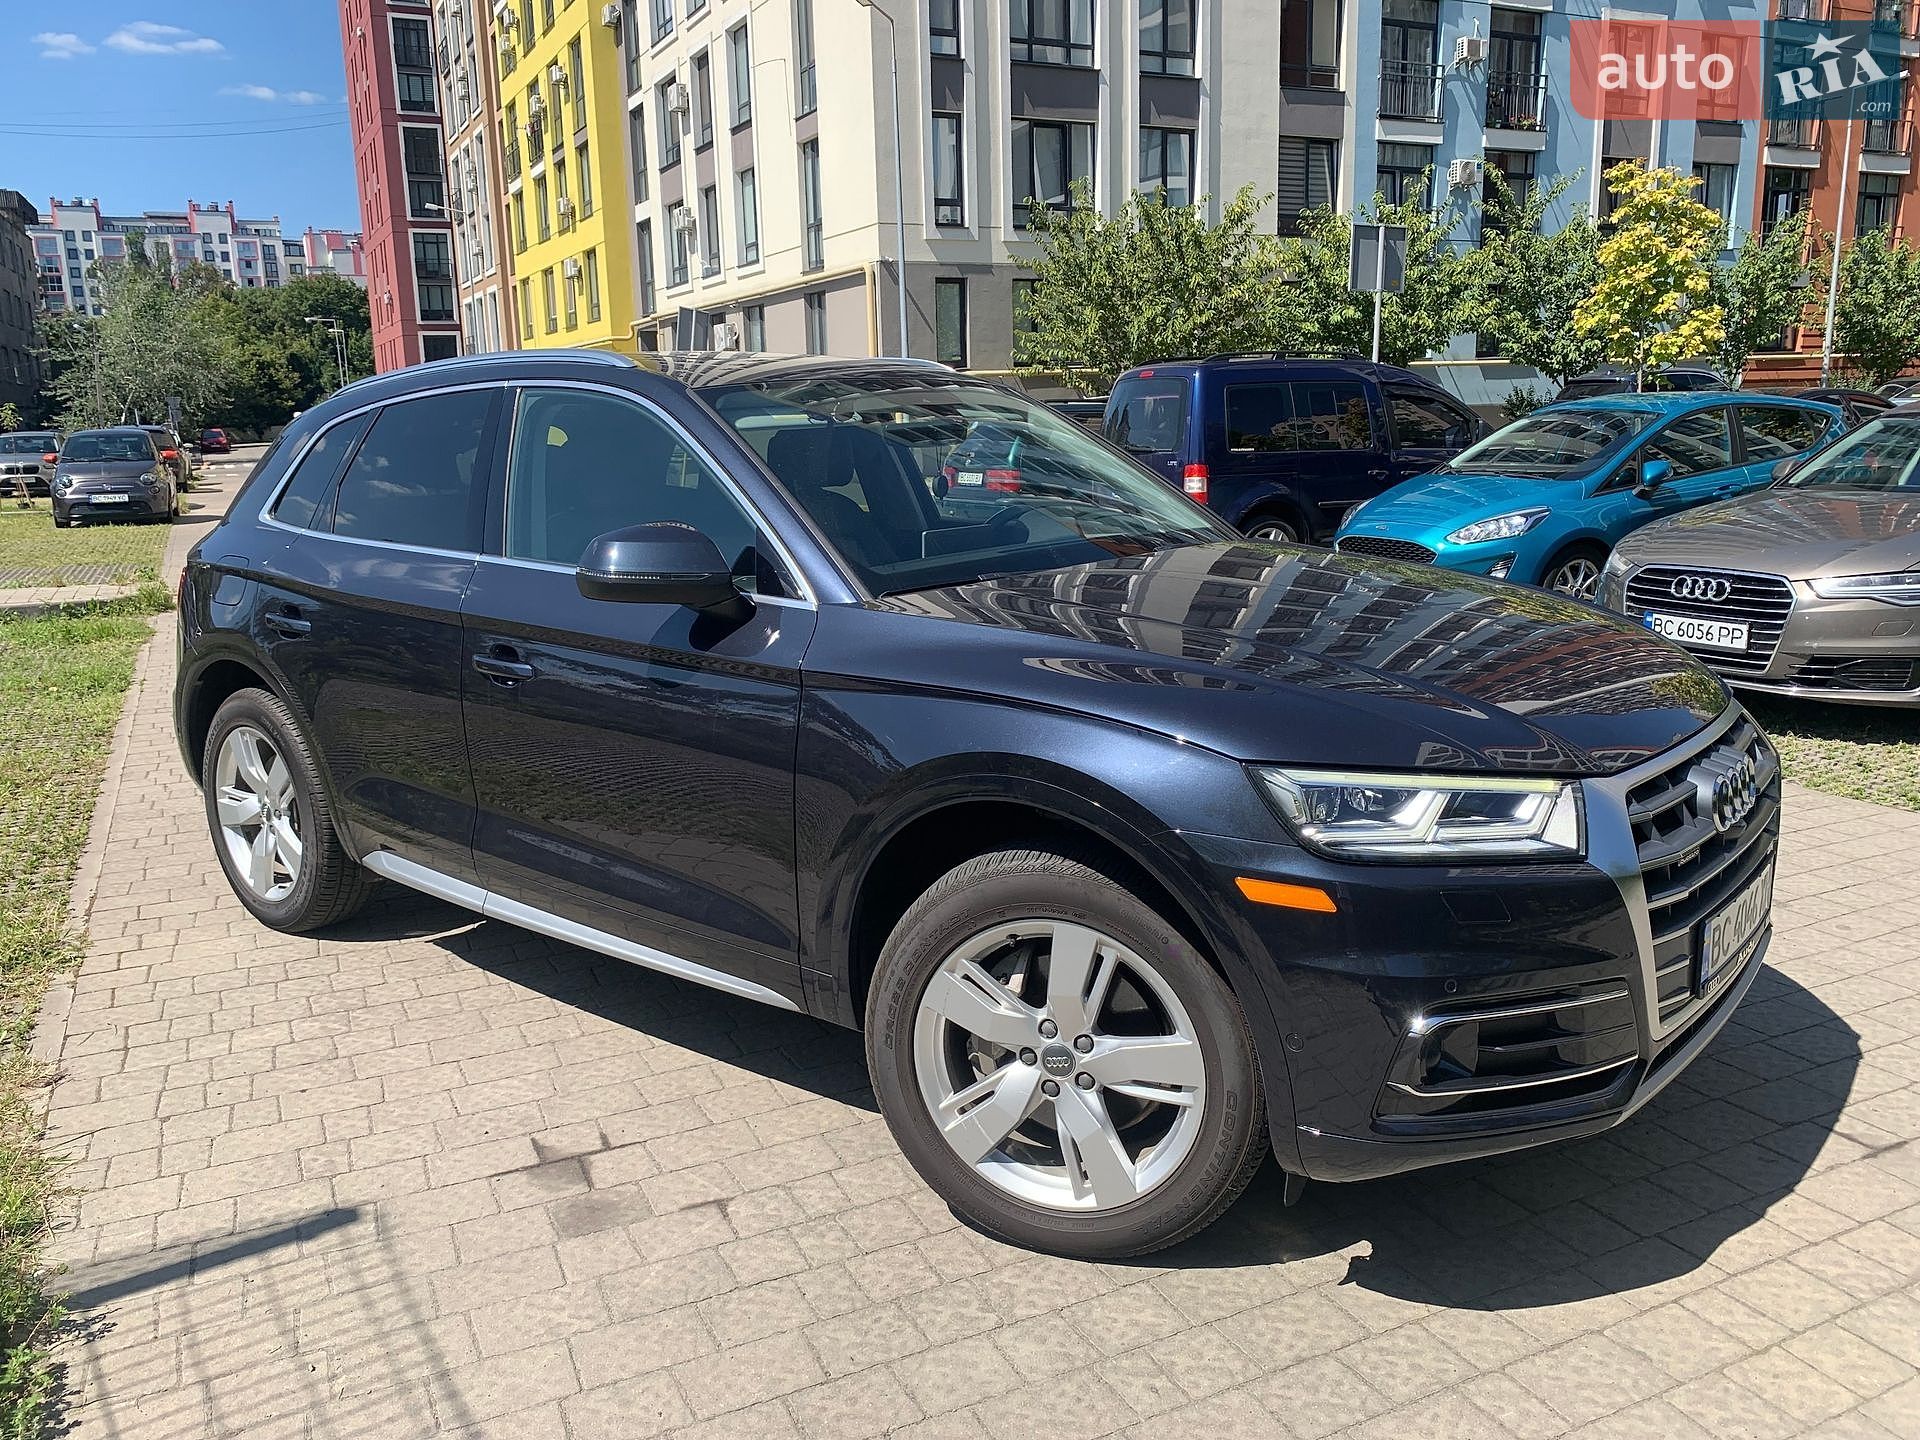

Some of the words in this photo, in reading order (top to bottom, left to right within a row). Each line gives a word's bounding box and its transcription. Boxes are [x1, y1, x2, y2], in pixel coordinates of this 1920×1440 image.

[1653, 617, 1674, 636] BC
[1677, 621, 1714, 642] 6056
[1717, 626, 1744, 645] PP
[1711, 915, 1732, 969] BC
